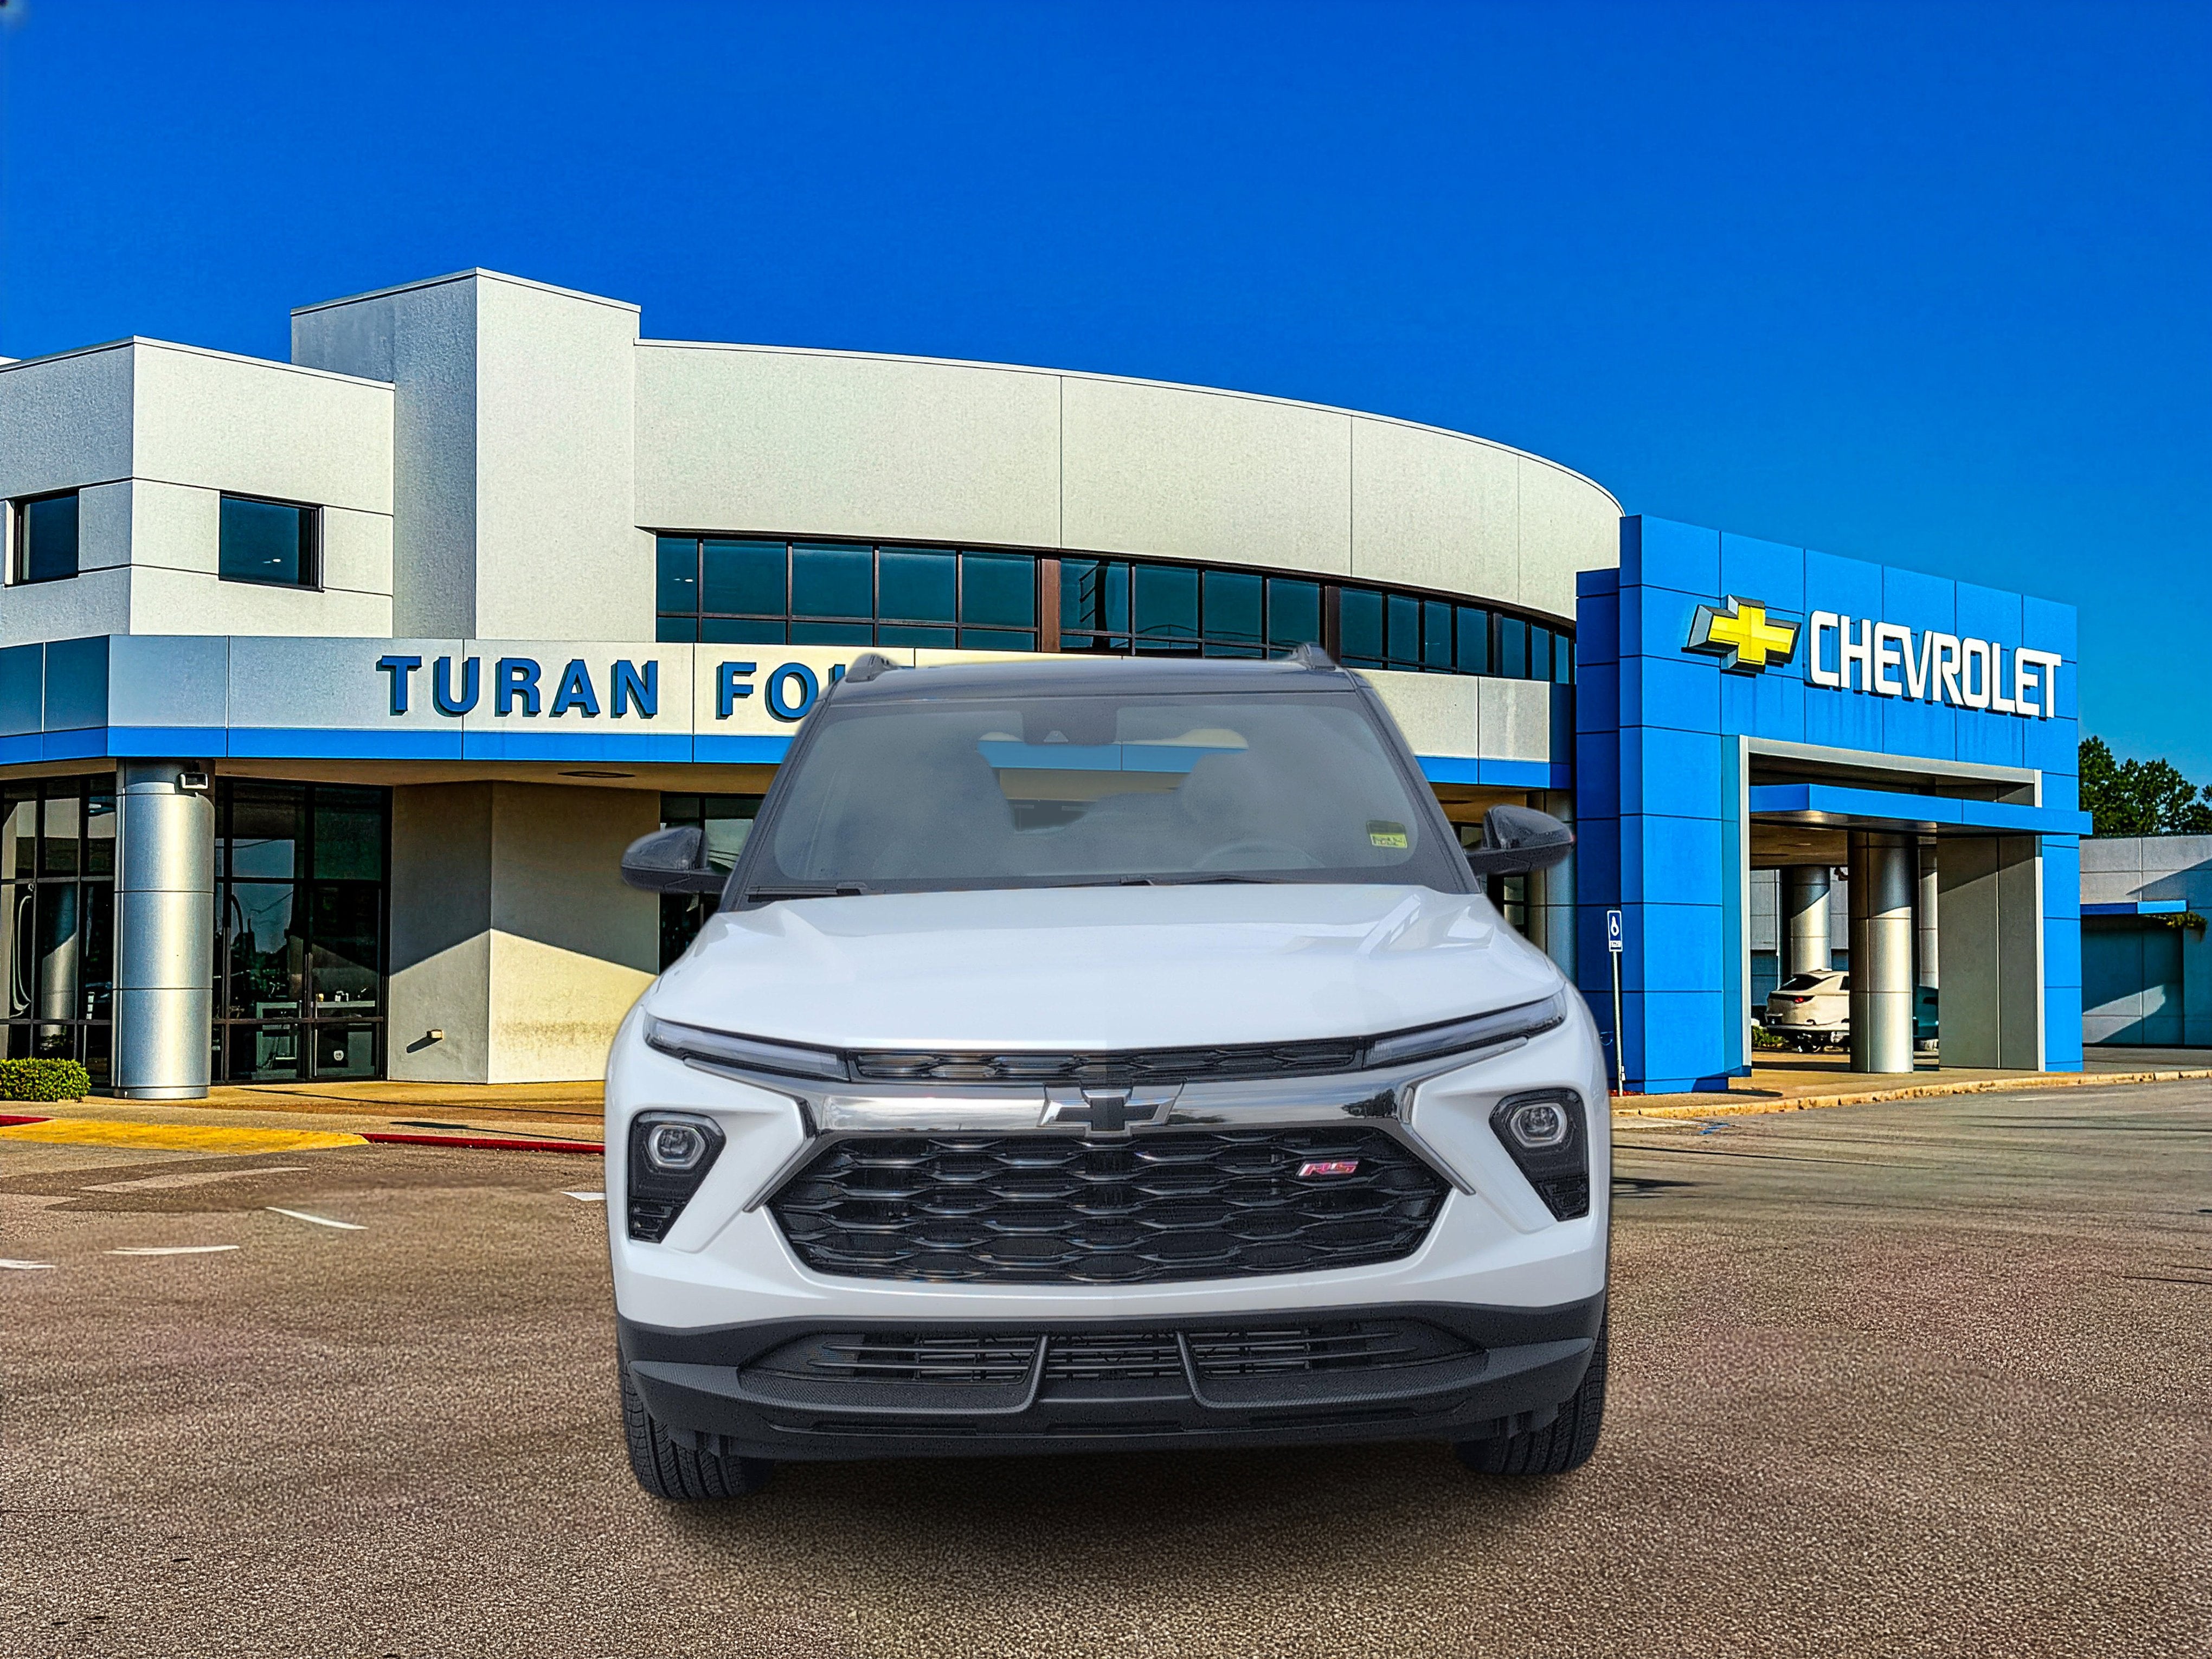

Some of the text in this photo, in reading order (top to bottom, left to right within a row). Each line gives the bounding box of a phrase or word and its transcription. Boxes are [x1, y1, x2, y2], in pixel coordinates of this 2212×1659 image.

[376, 655, 658, 719] TURAN
[1810, 610, 2062, 718] CHEVROLET
[1297, 1160, 1359, 1176] RS
